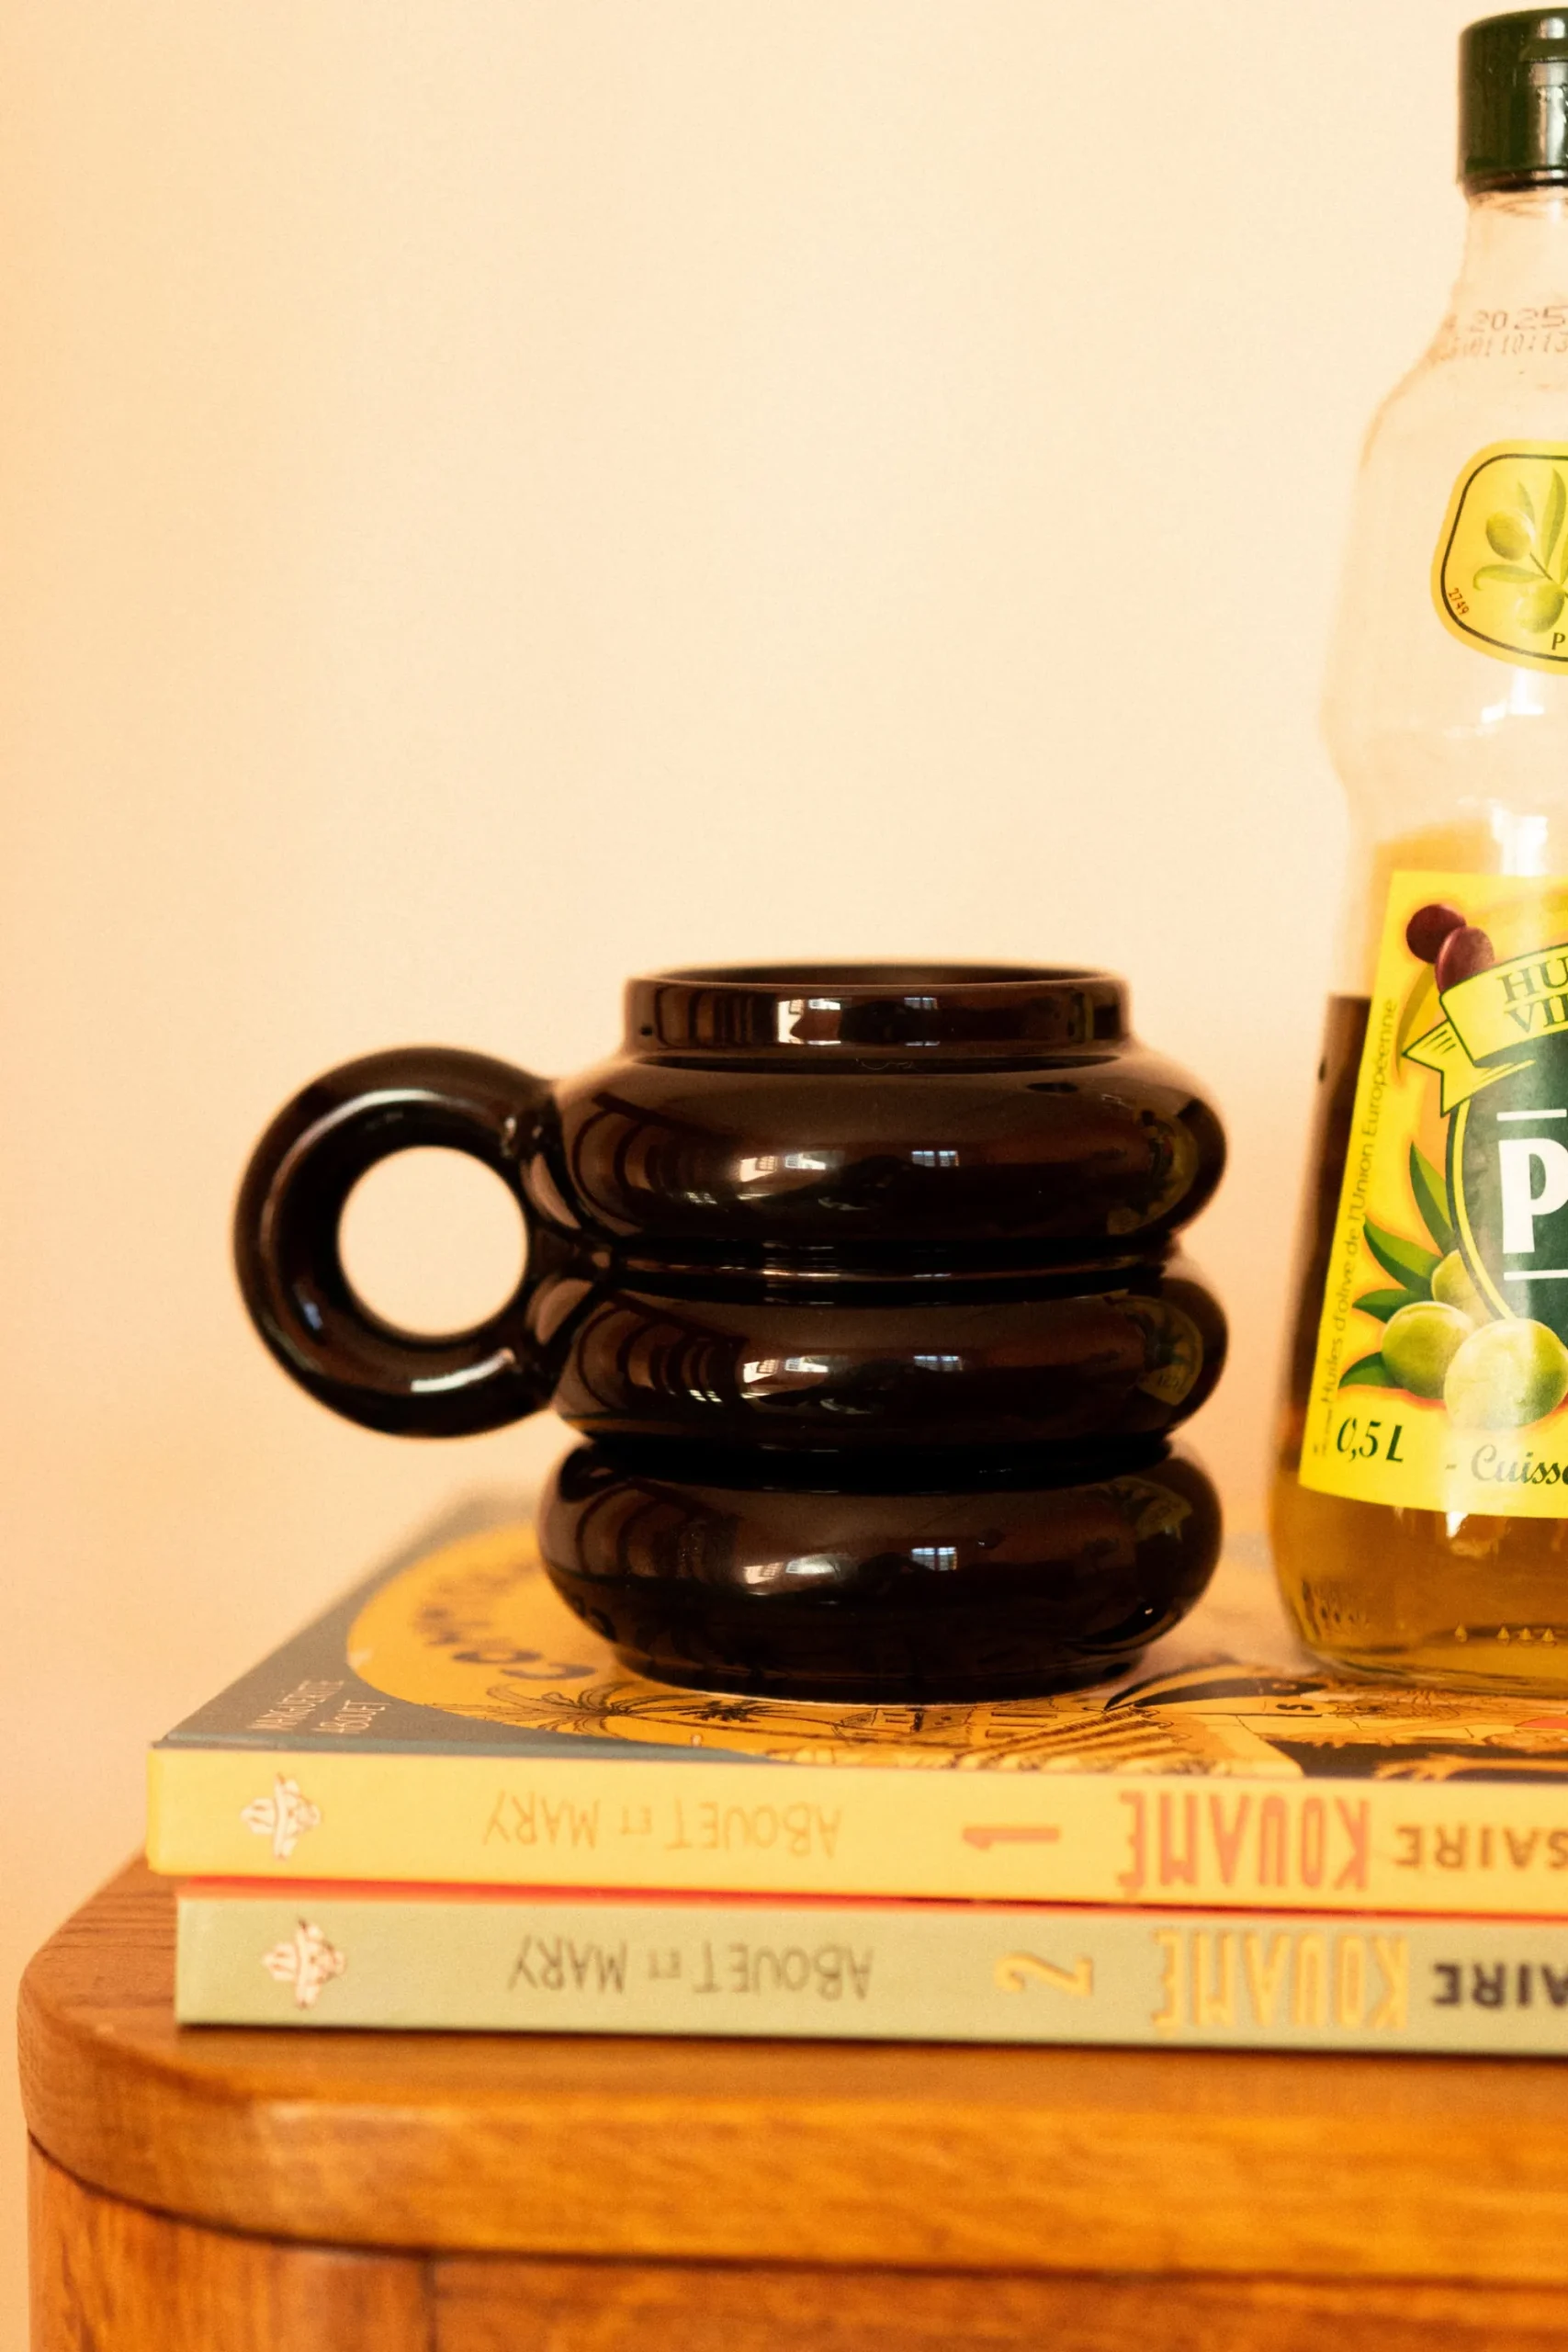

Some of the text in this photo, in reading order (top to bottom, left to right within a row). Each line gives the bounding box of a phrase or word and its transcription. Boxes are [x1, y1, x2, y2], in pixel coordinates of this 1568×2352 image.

[1448, 587, 1470, 616] 2749
[1551, 632, 1565, 650] P
[1344, 1228, 1361, 1256] de
[1361, 999, 1397, 1136] Européenne
[1498, 1137, 1568, 1254] P
[1337, 1417, 1382, 1463] 0,5
[1385, 1424, 1404, 1464] L
[482, 1789, 601, 1850] MARY
[620, 1804, 652, 1837] ET
[663, 1796, 843, 1860] ABOUET
[506, 1933, 628, 1995] MARY
[648, 1948, 682, 1980] ET
[692, 1938, 875, 2002] ABOUET
[995, 1950, 1094, 1998] 2
